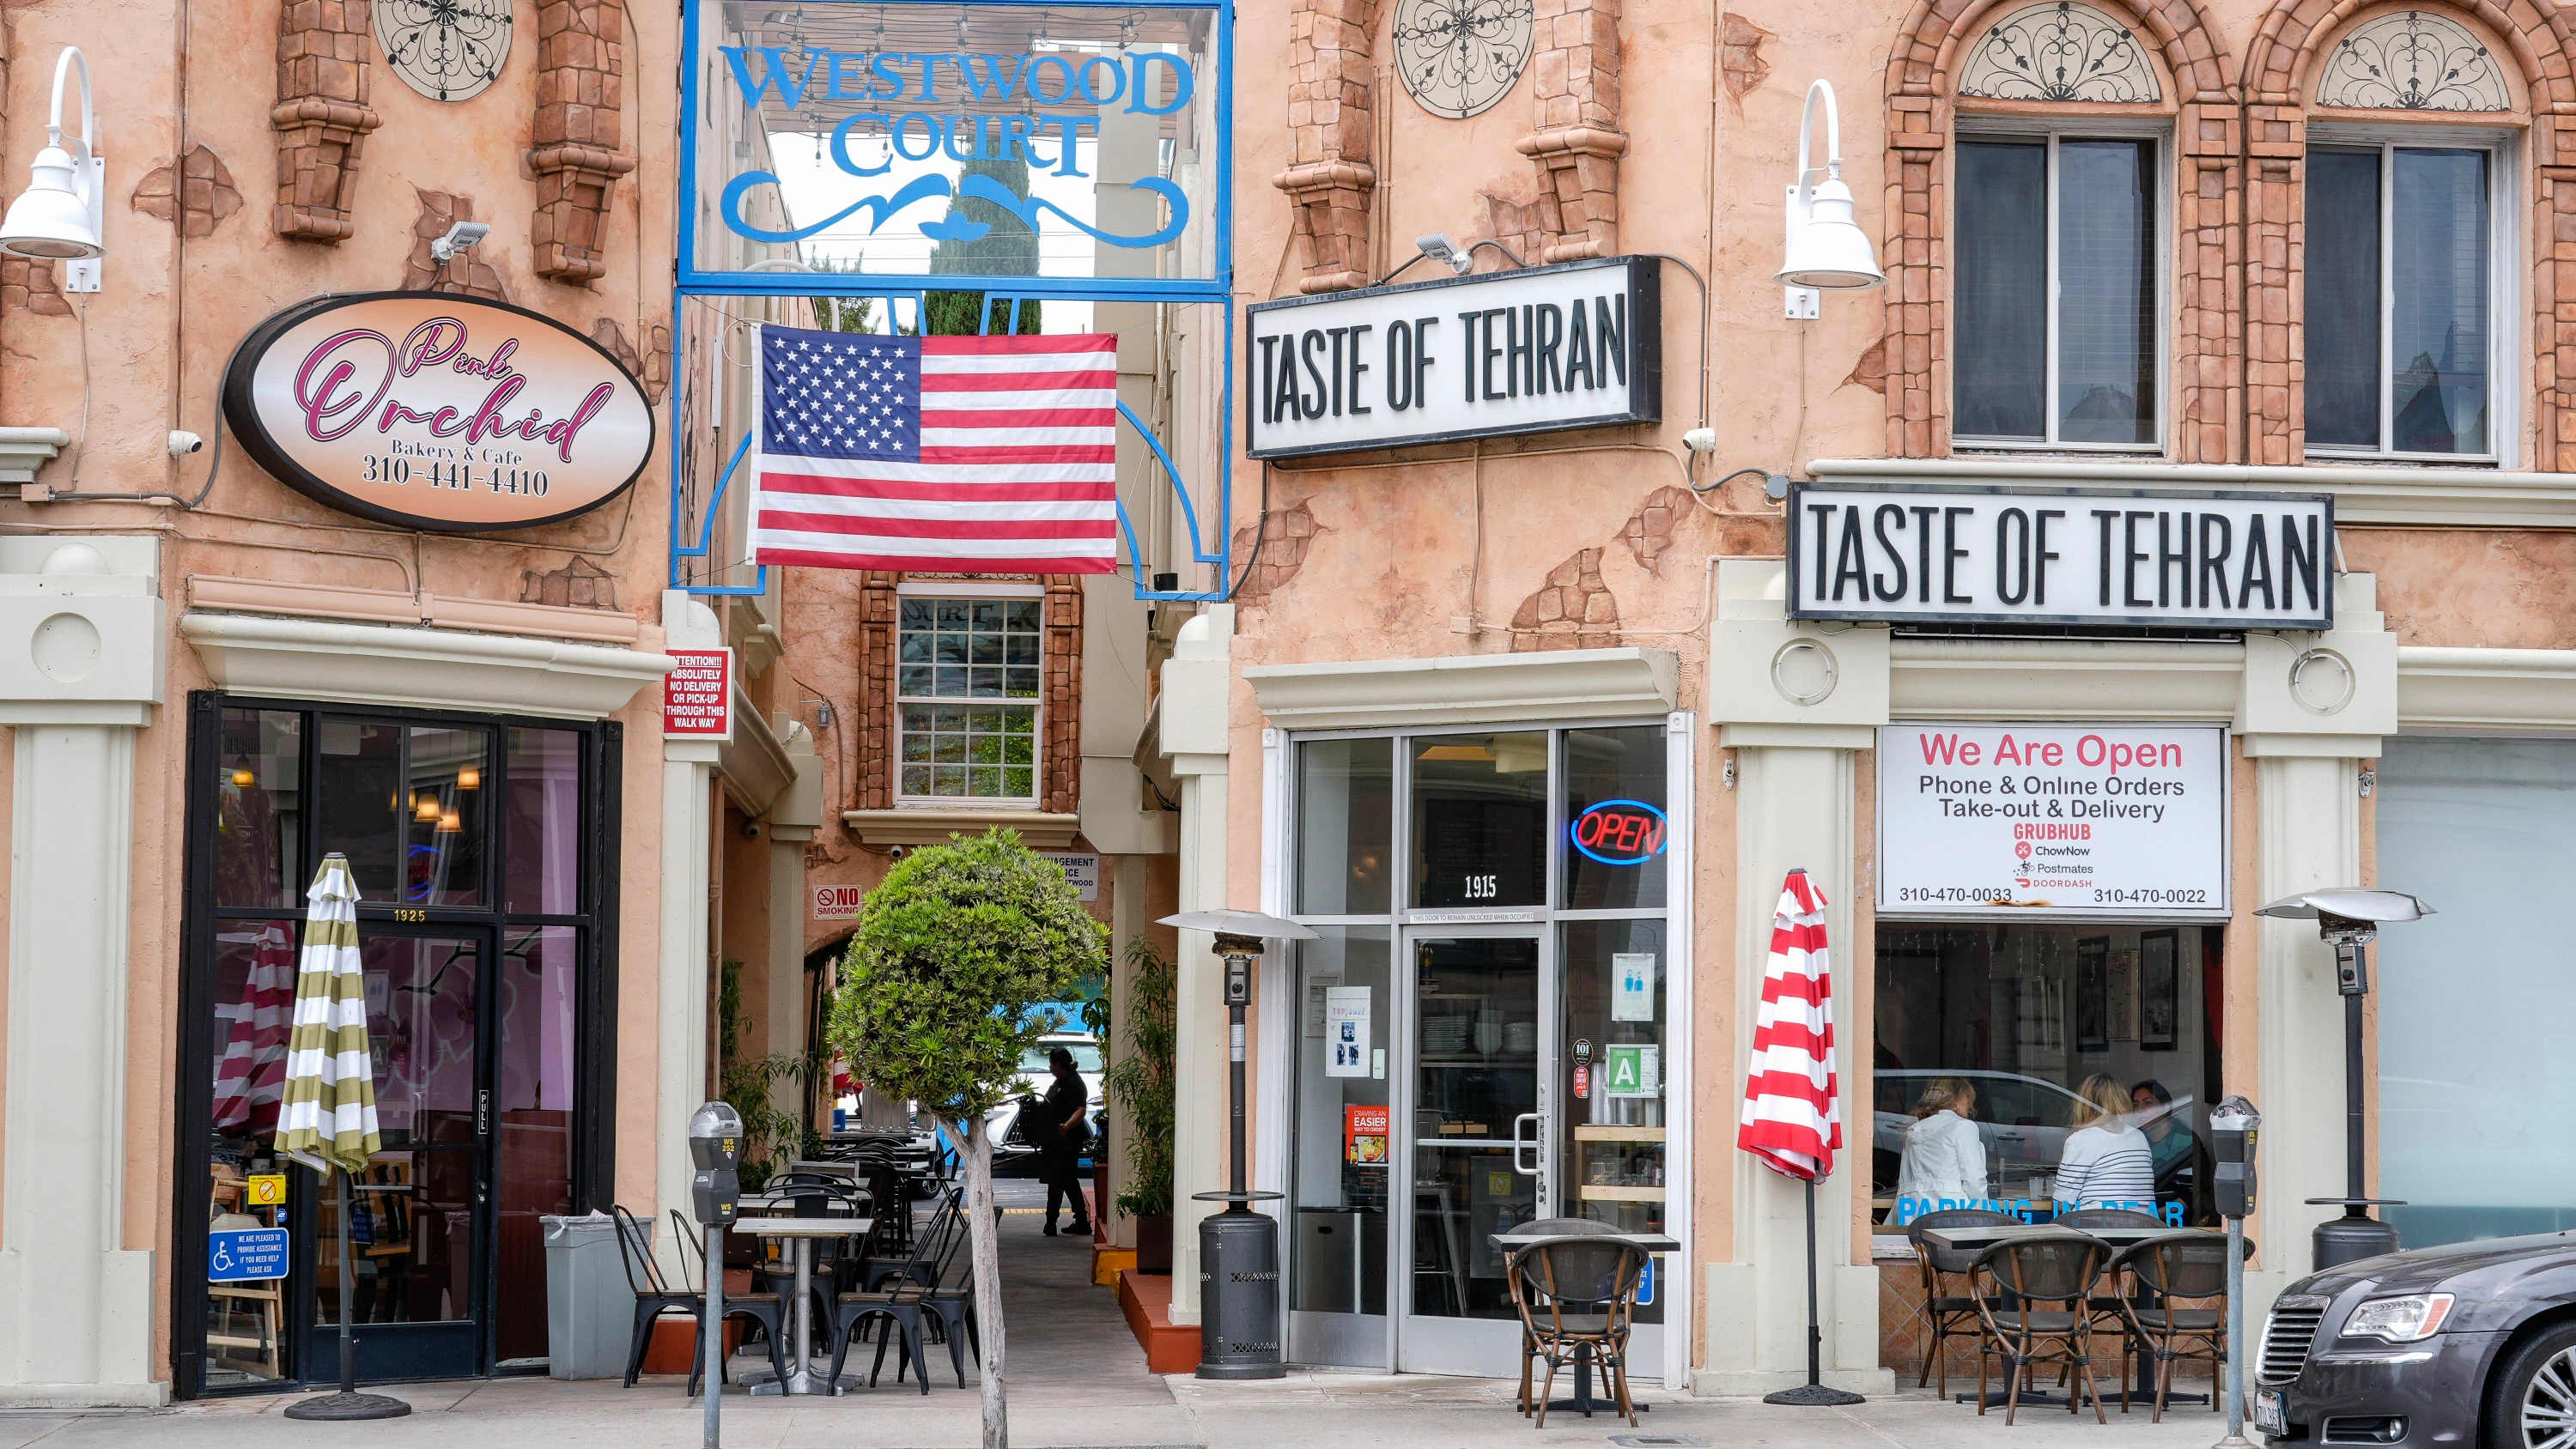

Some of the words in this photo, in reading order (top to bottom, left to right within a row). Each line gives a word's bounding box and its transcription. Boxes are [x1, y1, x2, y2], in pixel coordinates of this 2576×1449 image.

[717, 45, 1194, 116] WESTWOOD
[829, 112, 1101, 178] COURT
[399, 317, 519, 380] Pink
[1257, 324, 1372, 424] TASTE
[1387, 317, 1439, 412] OF
[1458, 293, 1625, 403] TEHRAN
[295, 329, 615, 464] Orchid
[391, 439, 457, 464] Bakery
[463, 446, 477, 462] &
[482, 447, 523, 467] Cafe
[362, 454, 550, 498] 310-441-4410
[1807, 504, 1974, 603] TASTE
[1996, 506, 2065, 606] OF
[2090, 509, 2319, 610] TEHRAN
[674, 656, 722, 667] TTENTION!!!
[671, 670, 721, 680] ABSOLUTELY
[670, 681, 682, 691] NO
[683, 682, 722, 692] DELIVERY
[672, 694, 685, 703] OR
[687, 694, 719, 704] PICK-UP
[666, 706, 704, 716] THROUGH
[707, 706, 725, 717] THIS
[674, 718, 696, 728] WALK
[698, 718, 715, 728] WAY
[1920, 733, 1981, 767] We
[1994, 733, 2063, 767] Are
[2076, 734, 2183, 775] Open
[1919, 775, 1992, 795] Phone
[2000, 775, 2017, 795] &
[2023, 775, 2098, 796] Online
[2105, 776, 2184, 796] Orders
[1939, 798, 2040, 818] Take-out
[2047, 798, 2064, 818] &
[2071, 799, 2166, 824] Delivery
[1577, 811, 1664, 854] OPEN
[2014, 823, 2092, 840] GRUBHUB
[2035, 845, 2091, 857] ChowNow
[2037, 863, 2093, 874] Postmates
[1465, 875, 1497, 898] 1915
[2033, 879, 2092, 888] DOORDASH
[836, 888, 859, 906] NO
[1899, 888, 2013, 902] 310-470-0033
[2093, 888, 2206, 903] 310-470-0022
[394, 909, 426, 923] 1925
[817, 906, 859, 915] SMOKING
[1576, 1044, 1589, 1054] 101
[1614, 1058, 1635, 1085] A
[1354, 1117, 1387, 1127] EASIER
[237, 1245, 256, 1253] PROVIDE
[256, 1244, 283, 1252] ASSISTANCE
[267, 1254, 280, 1263] HELP
